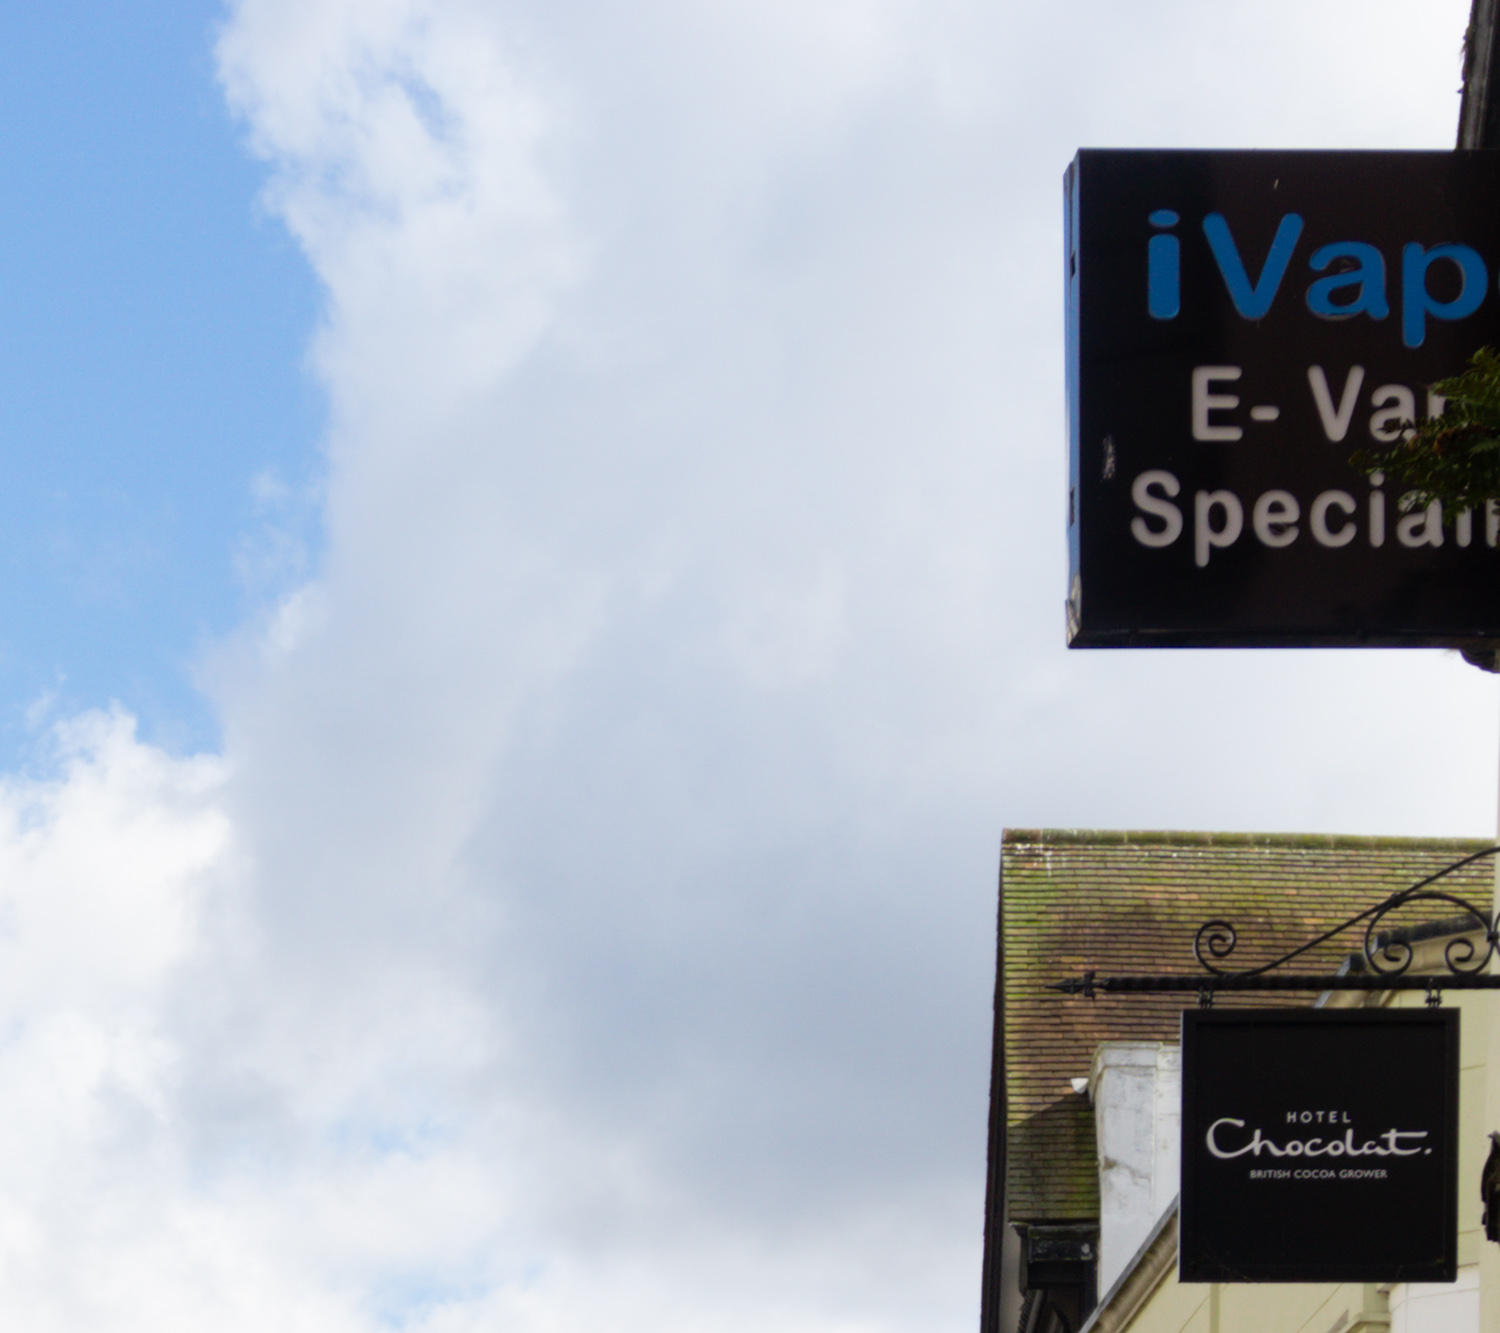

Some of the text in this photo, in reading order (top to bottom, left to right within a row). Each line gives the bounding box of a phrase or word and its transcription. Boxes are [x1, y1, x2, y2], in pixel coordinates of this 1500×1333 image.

[1286, 1110, 1352, 1124] HOTEL
[1249, 1169, 1388, 1179] BRITISH COCOA GROWER
